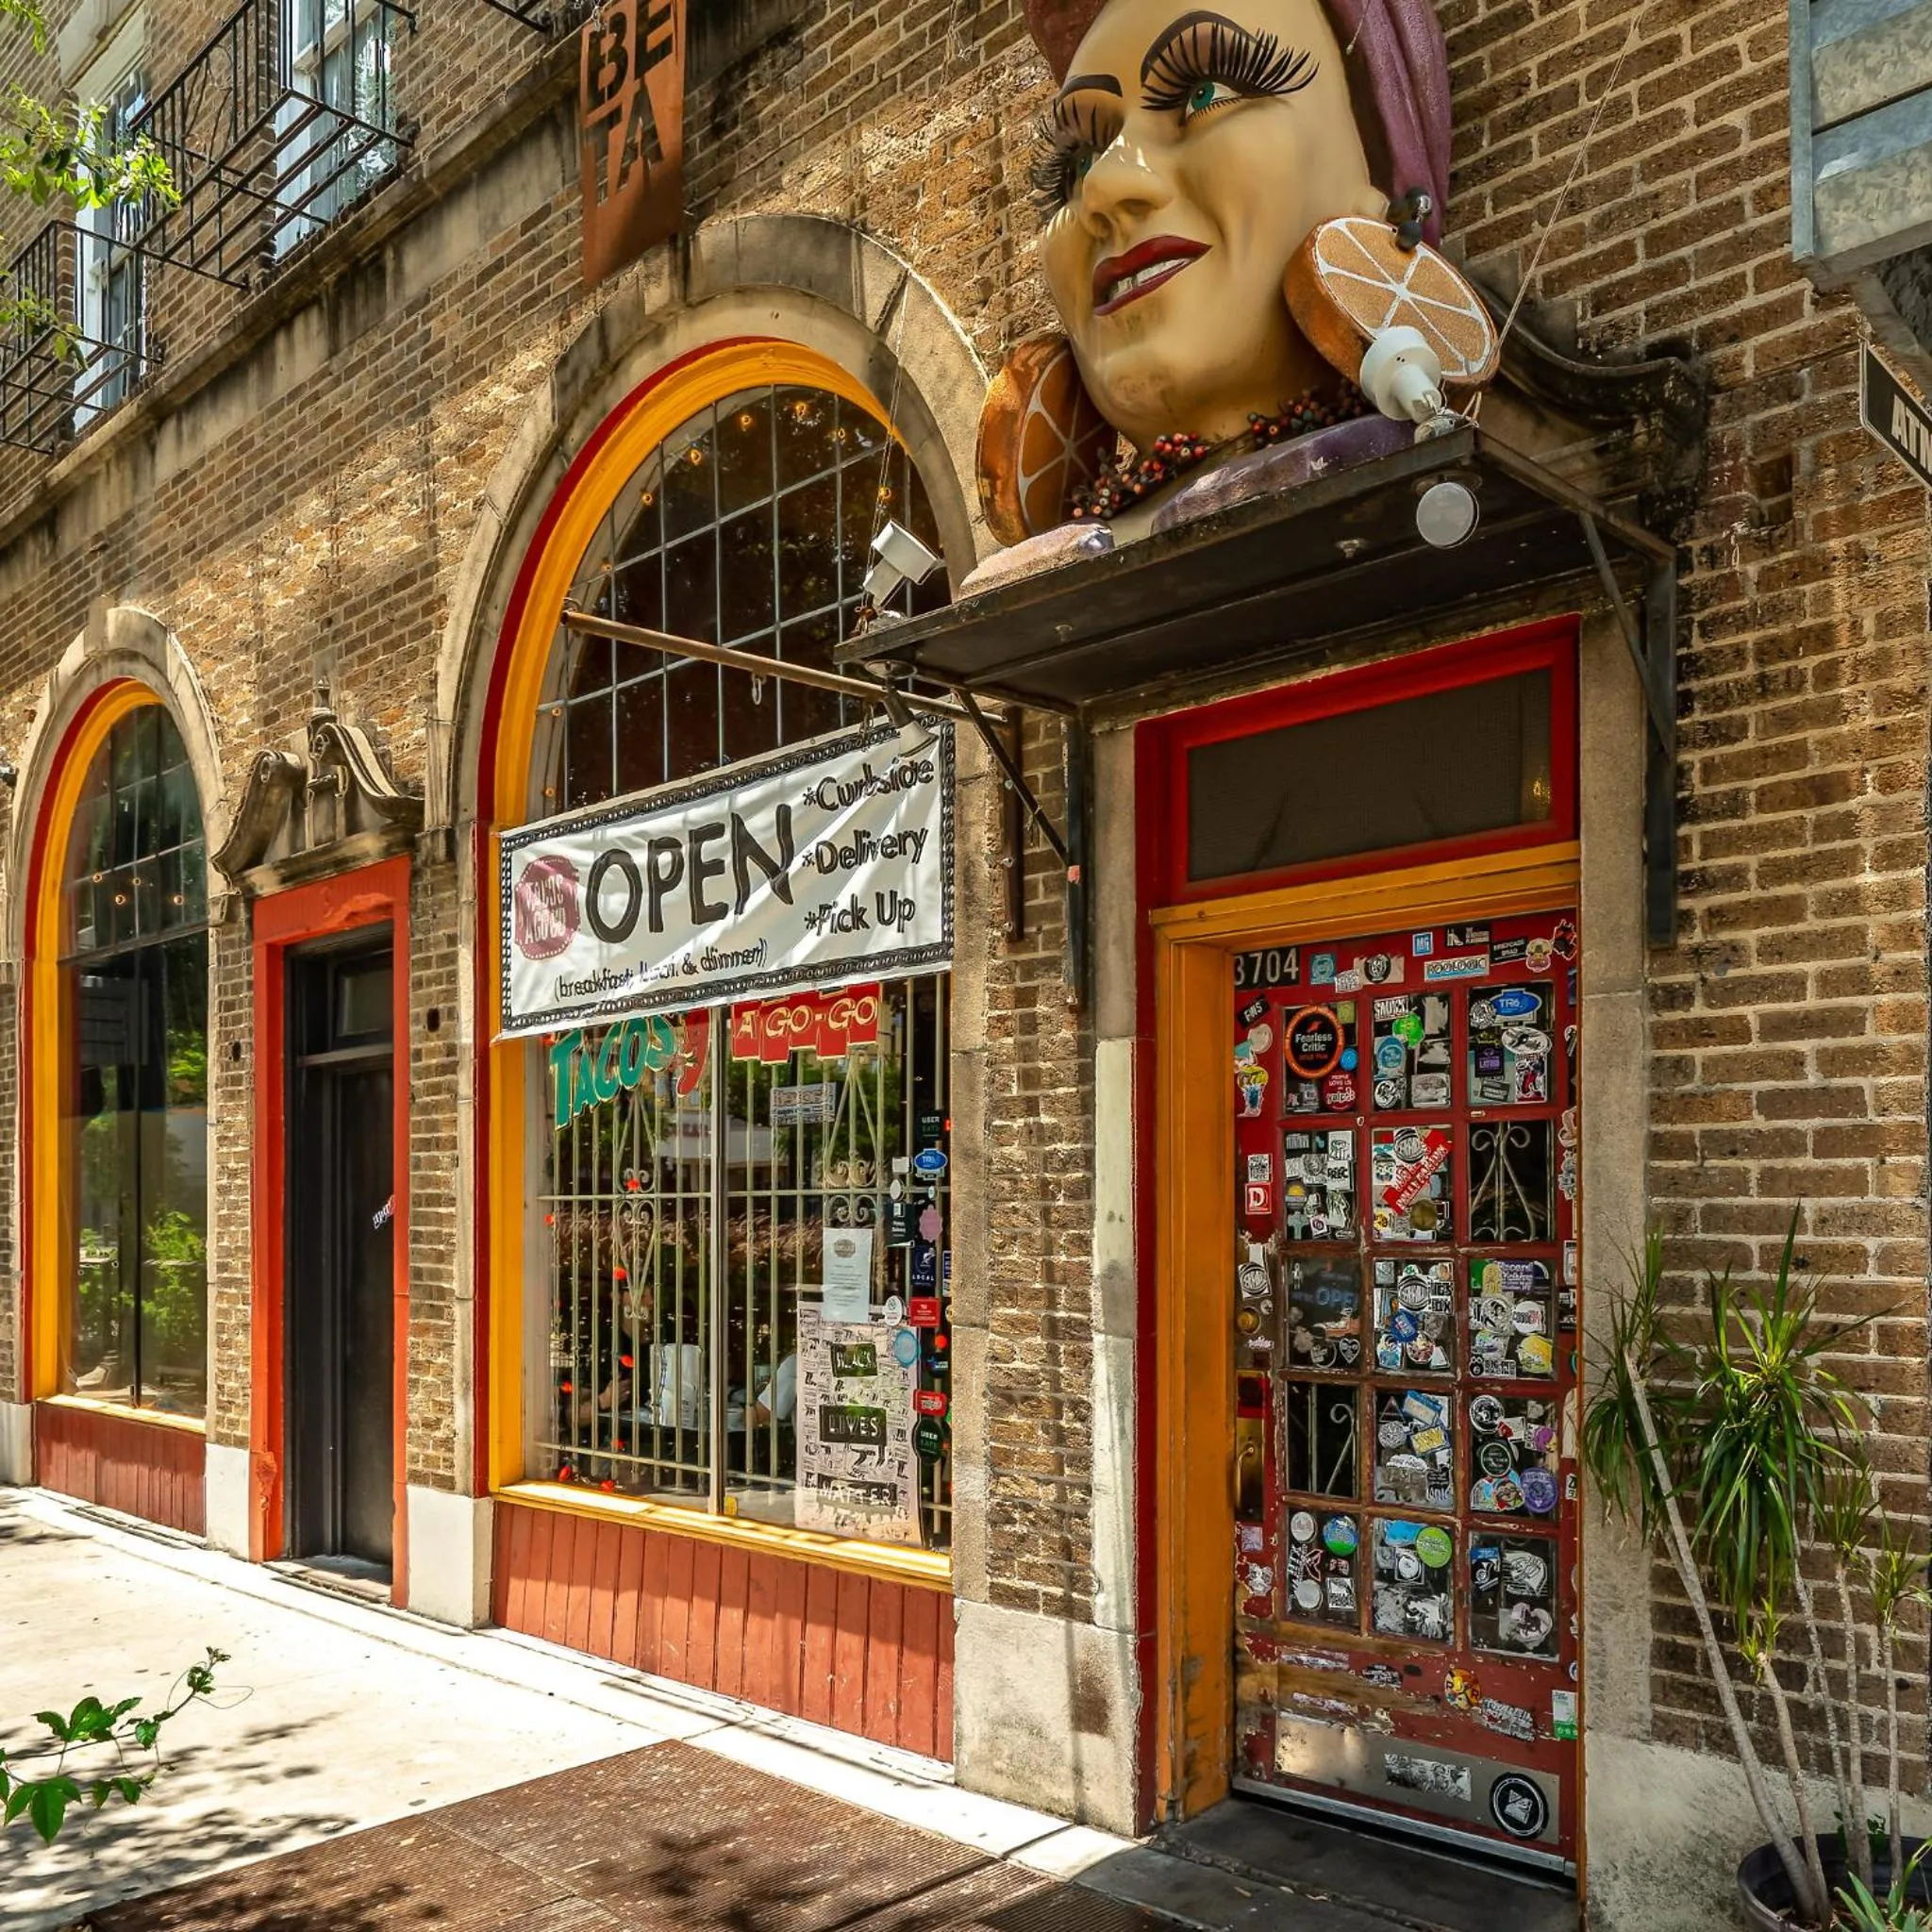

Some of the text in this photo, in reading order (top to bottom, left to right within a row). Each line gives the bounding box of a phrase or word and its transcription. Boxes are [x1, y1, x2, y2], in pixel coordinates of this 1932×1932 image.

[585, 804, 794, 943] OPEN
[875, 890, 916, 933] Up
[681, 952, 700, 975] &
[1235, 947, 1299, 987] 3704
[1295, 1032, 1333, 1043] Fearless
[1301, 1042, 1325, 1053] Critic
[550, 994, 879, 1131] TACOS A GO-GO
[828, 1414, 881, 1438] LIVES
[919, 1429, 939, 1442] UBER
[821, 1482, 892, 1507] MATTER
